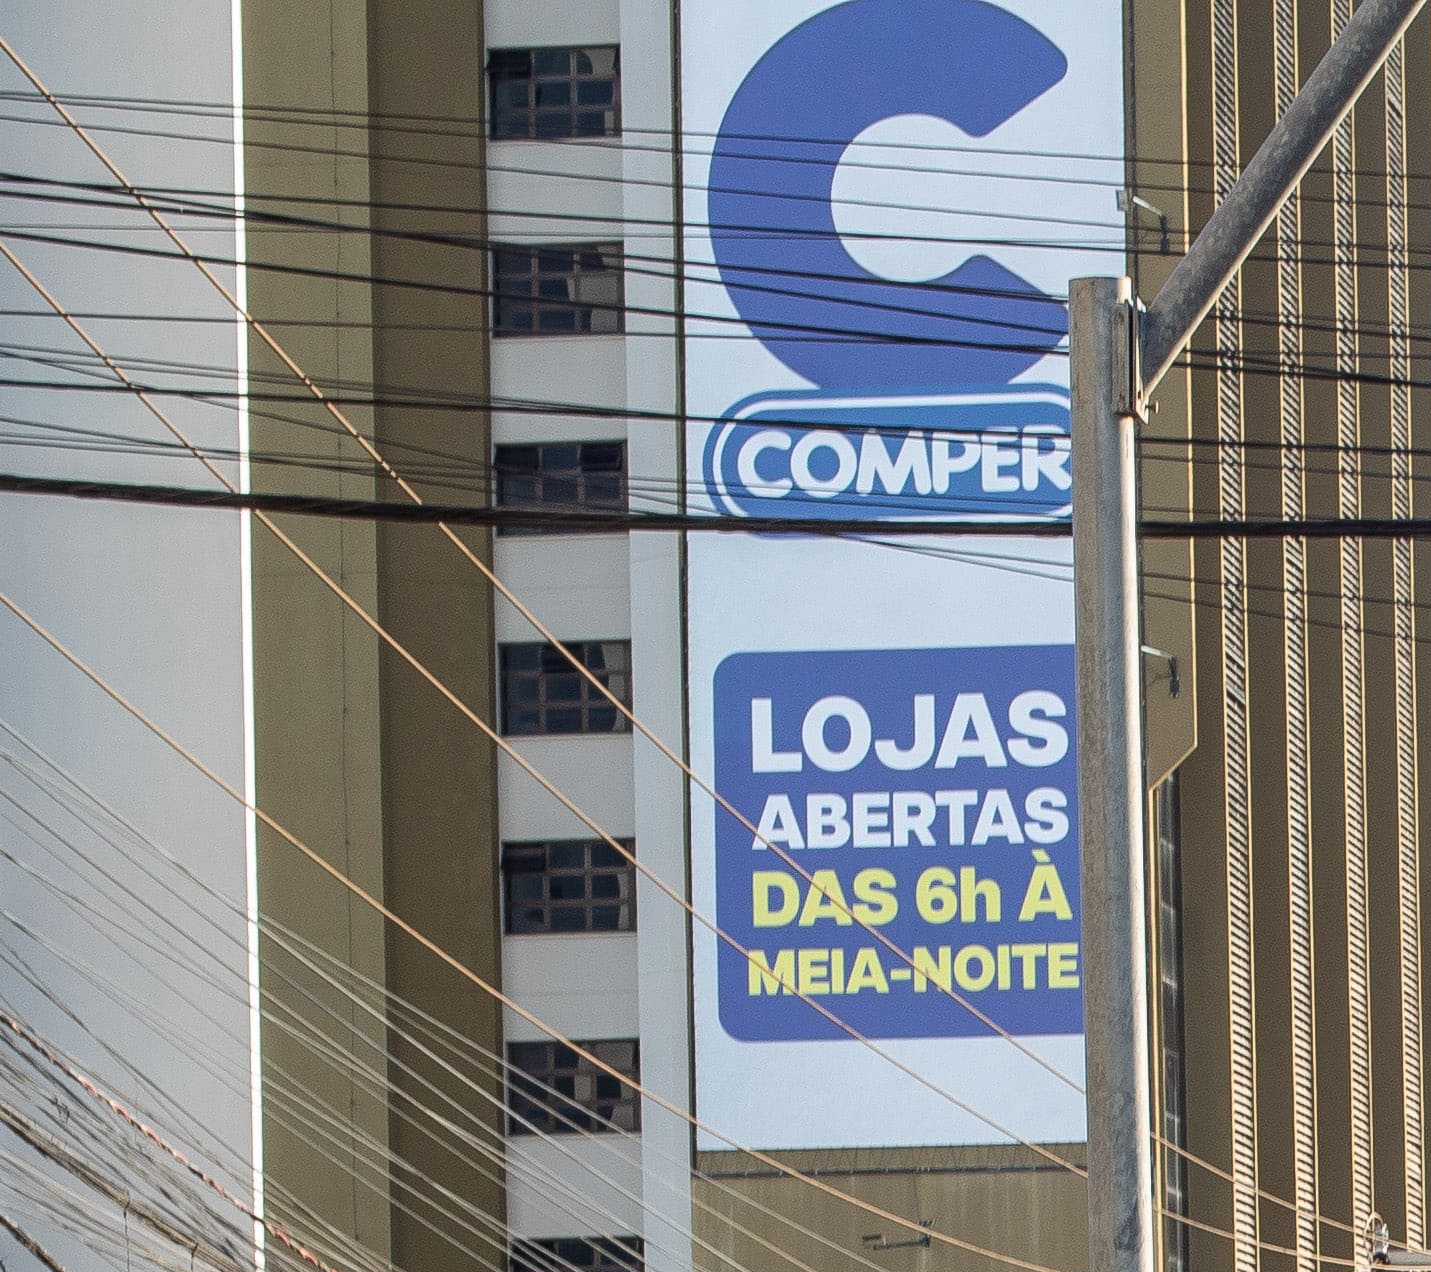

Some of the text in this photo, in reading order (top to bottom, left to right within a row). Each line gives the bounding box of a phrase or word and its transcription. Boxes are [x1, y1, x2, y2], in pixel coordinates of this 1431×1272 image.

[738, 424, 1071, 498] COMPER
[750, 690, 1070, 774] LOJAS
[751, 787, 1070, 851] ABERTAS
[752, 848, 1074, 928] DAS 6h À
[748, 942, 1081, 997] MEIA-NOITE
